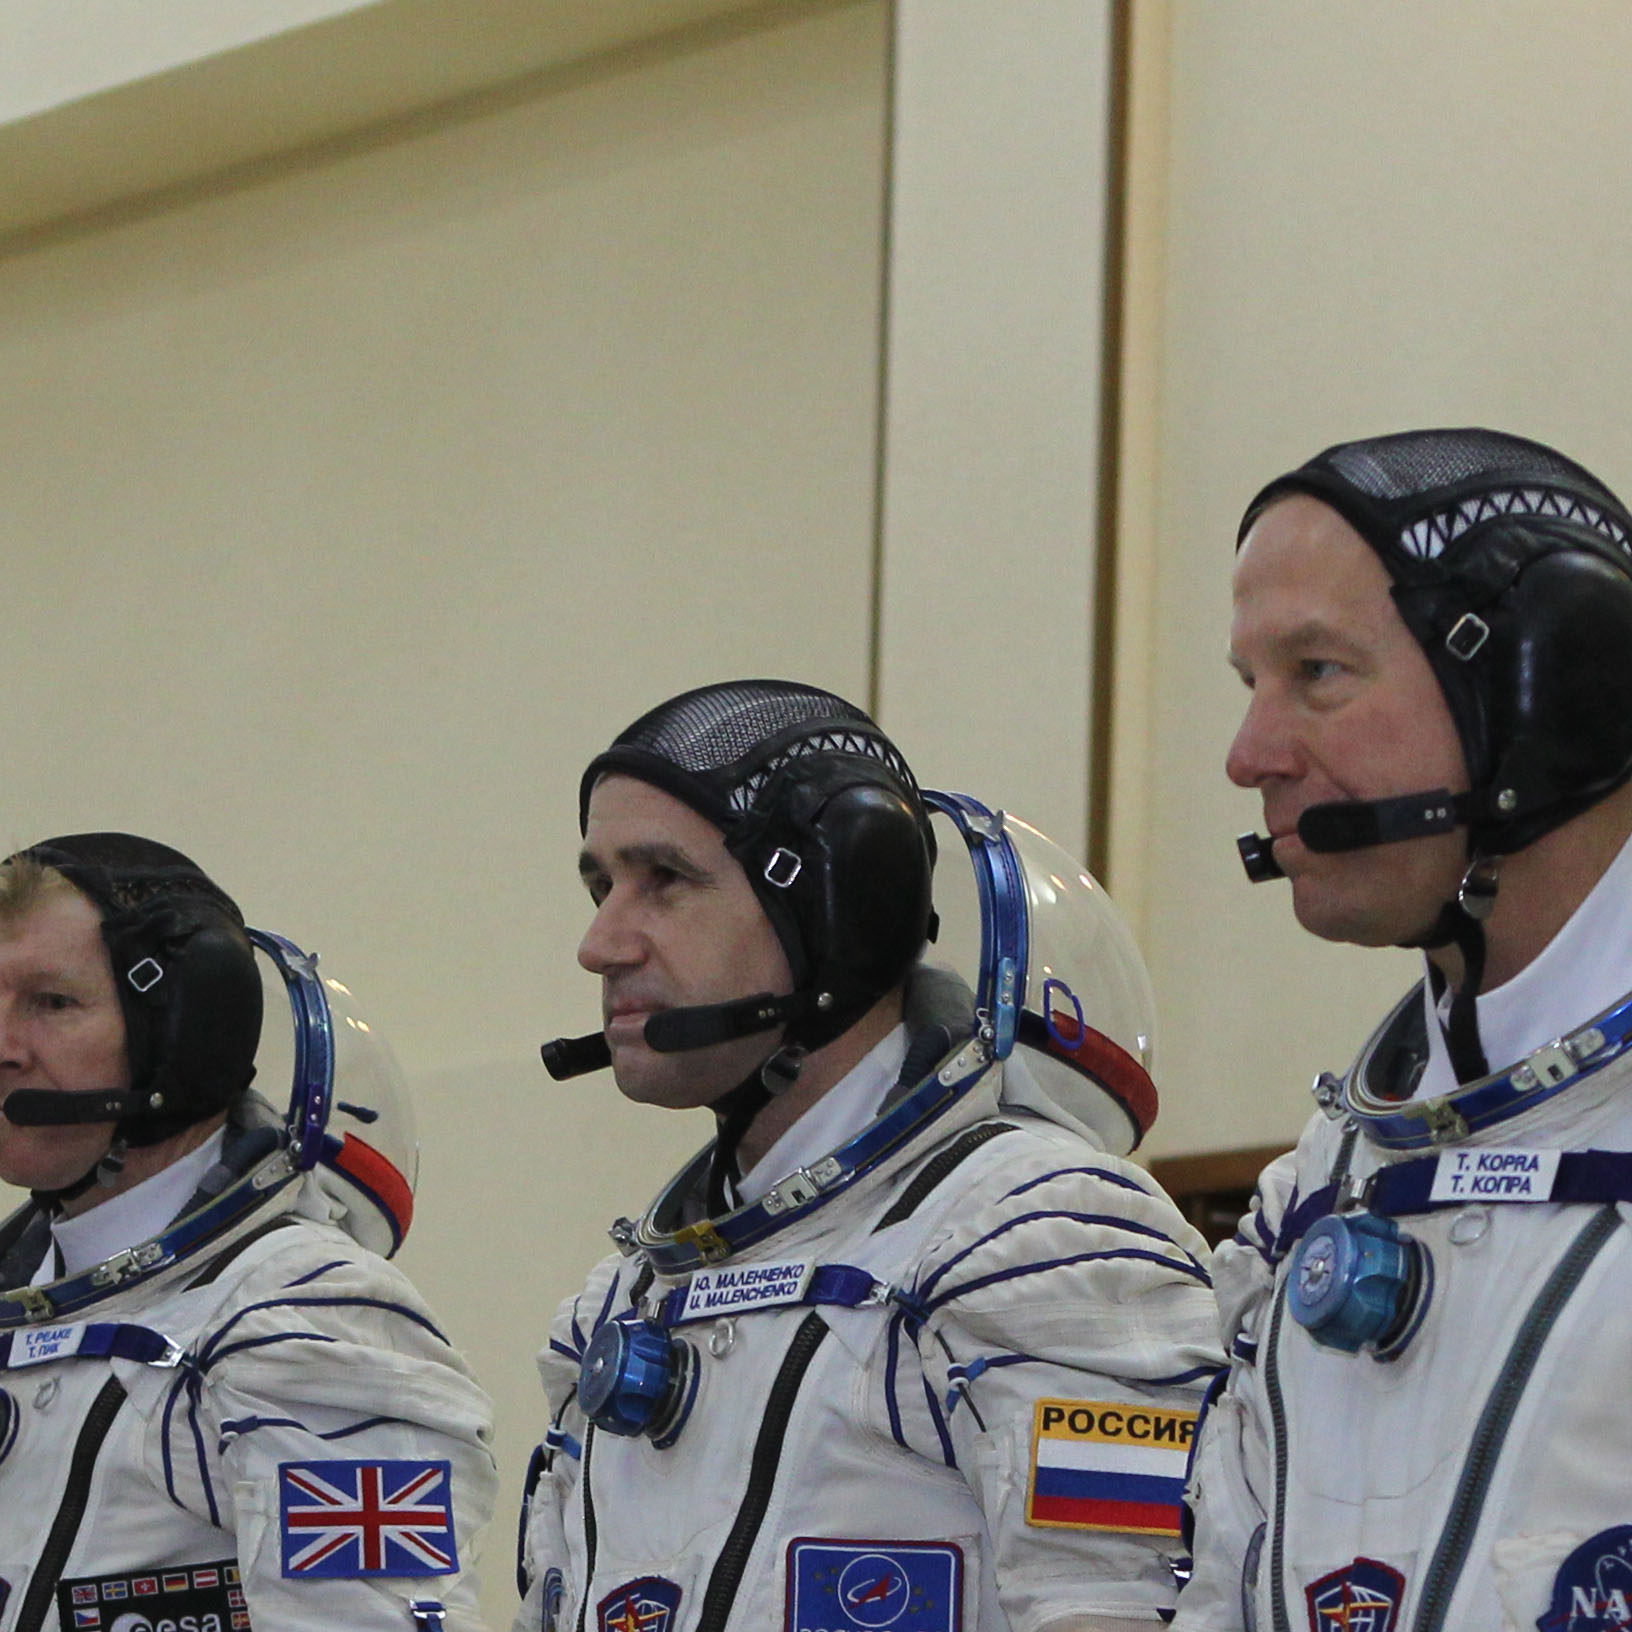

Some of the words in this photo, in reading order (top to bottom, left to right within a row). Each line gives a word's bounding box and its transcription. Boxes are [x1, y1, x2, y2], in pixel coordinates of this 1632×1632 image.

[1456, 1153, 1470, 1171] T.
[1477, 1154, 1540, 1172] KOPRA
[1451, 1175, 1464, 1193] Т.
[1470, 1175, 1531, 1193] КОПРА
[693, 1276, 711, 1292] Ю.
[715, 1264, 806, 1289] МАЛЕНЧЕНКО
[706, 1281, 798, 1307] MALENCHENKO
[1042, 1405, 1198, 1444] РОССИЯ
